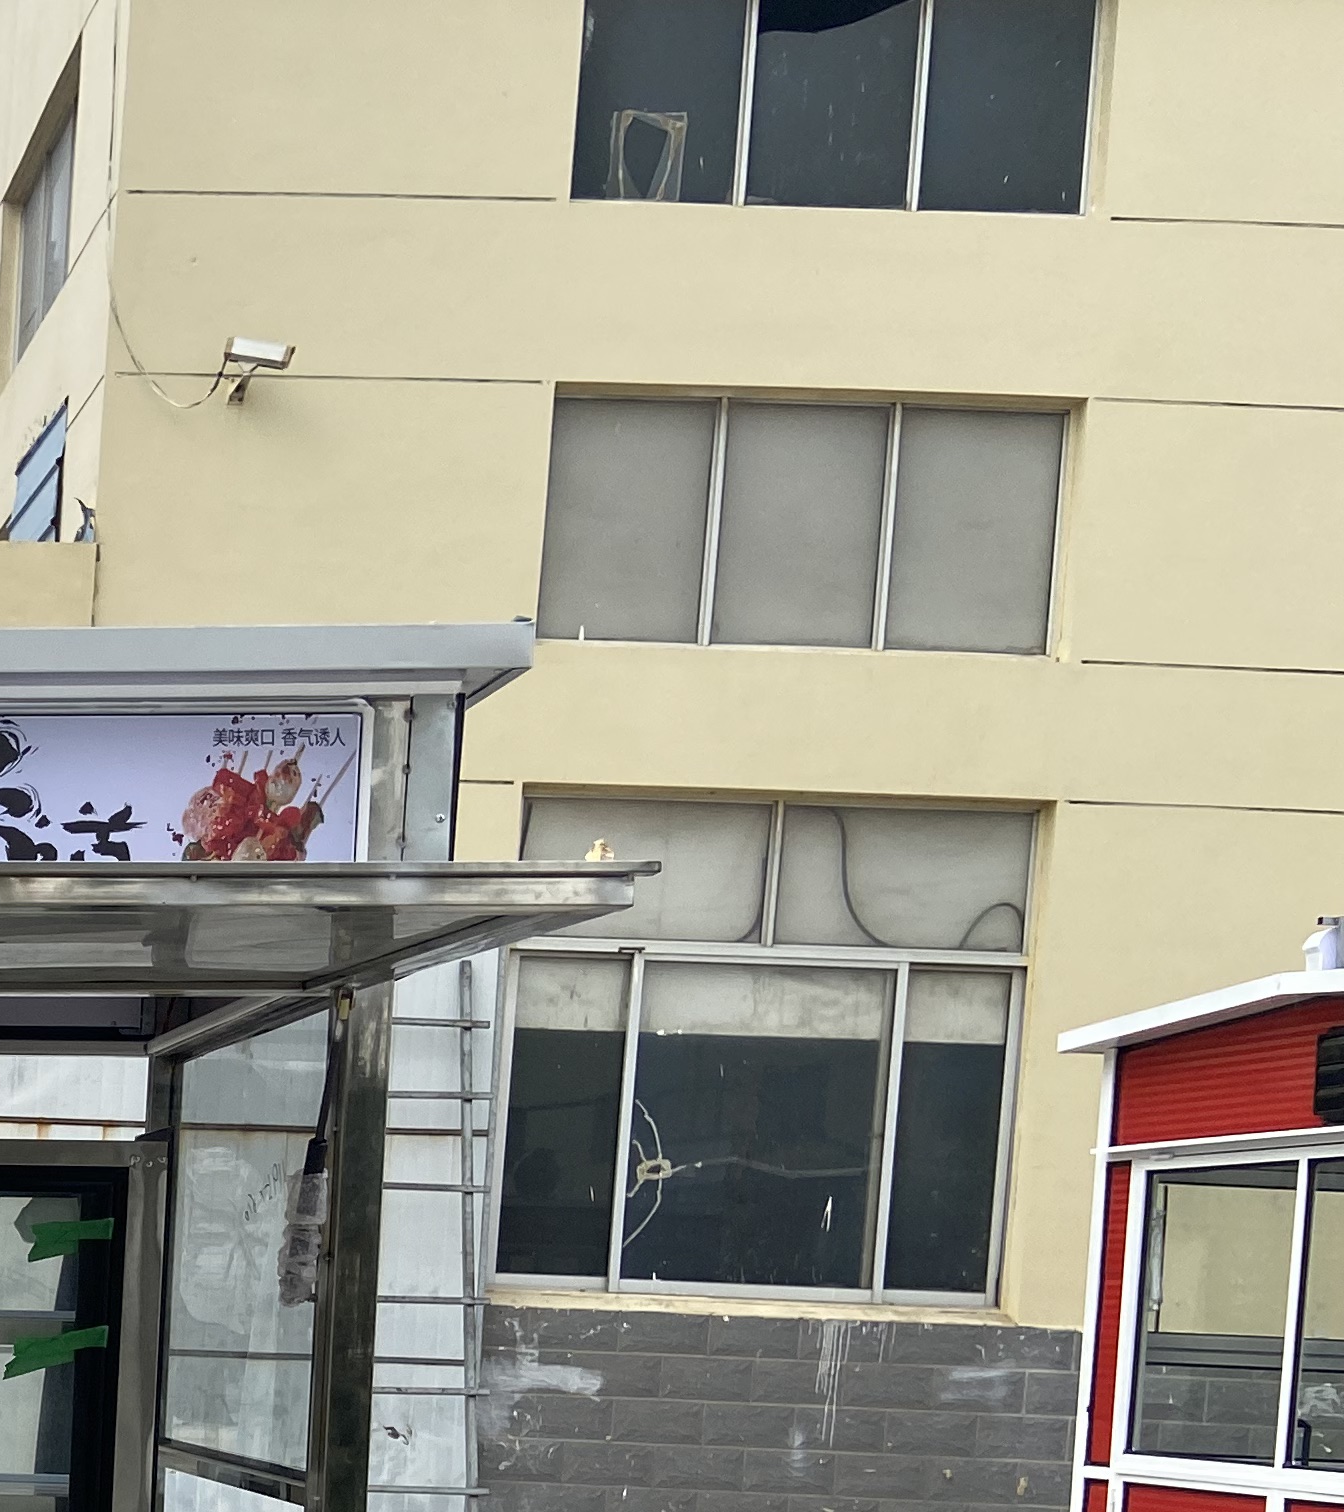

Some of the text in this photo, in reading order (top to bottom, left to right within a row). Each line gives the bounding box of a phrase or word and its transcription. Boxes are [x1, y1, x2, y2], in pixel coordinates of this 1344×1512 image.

[213, 727, 346, 747] 美味爽口 香气诱人
